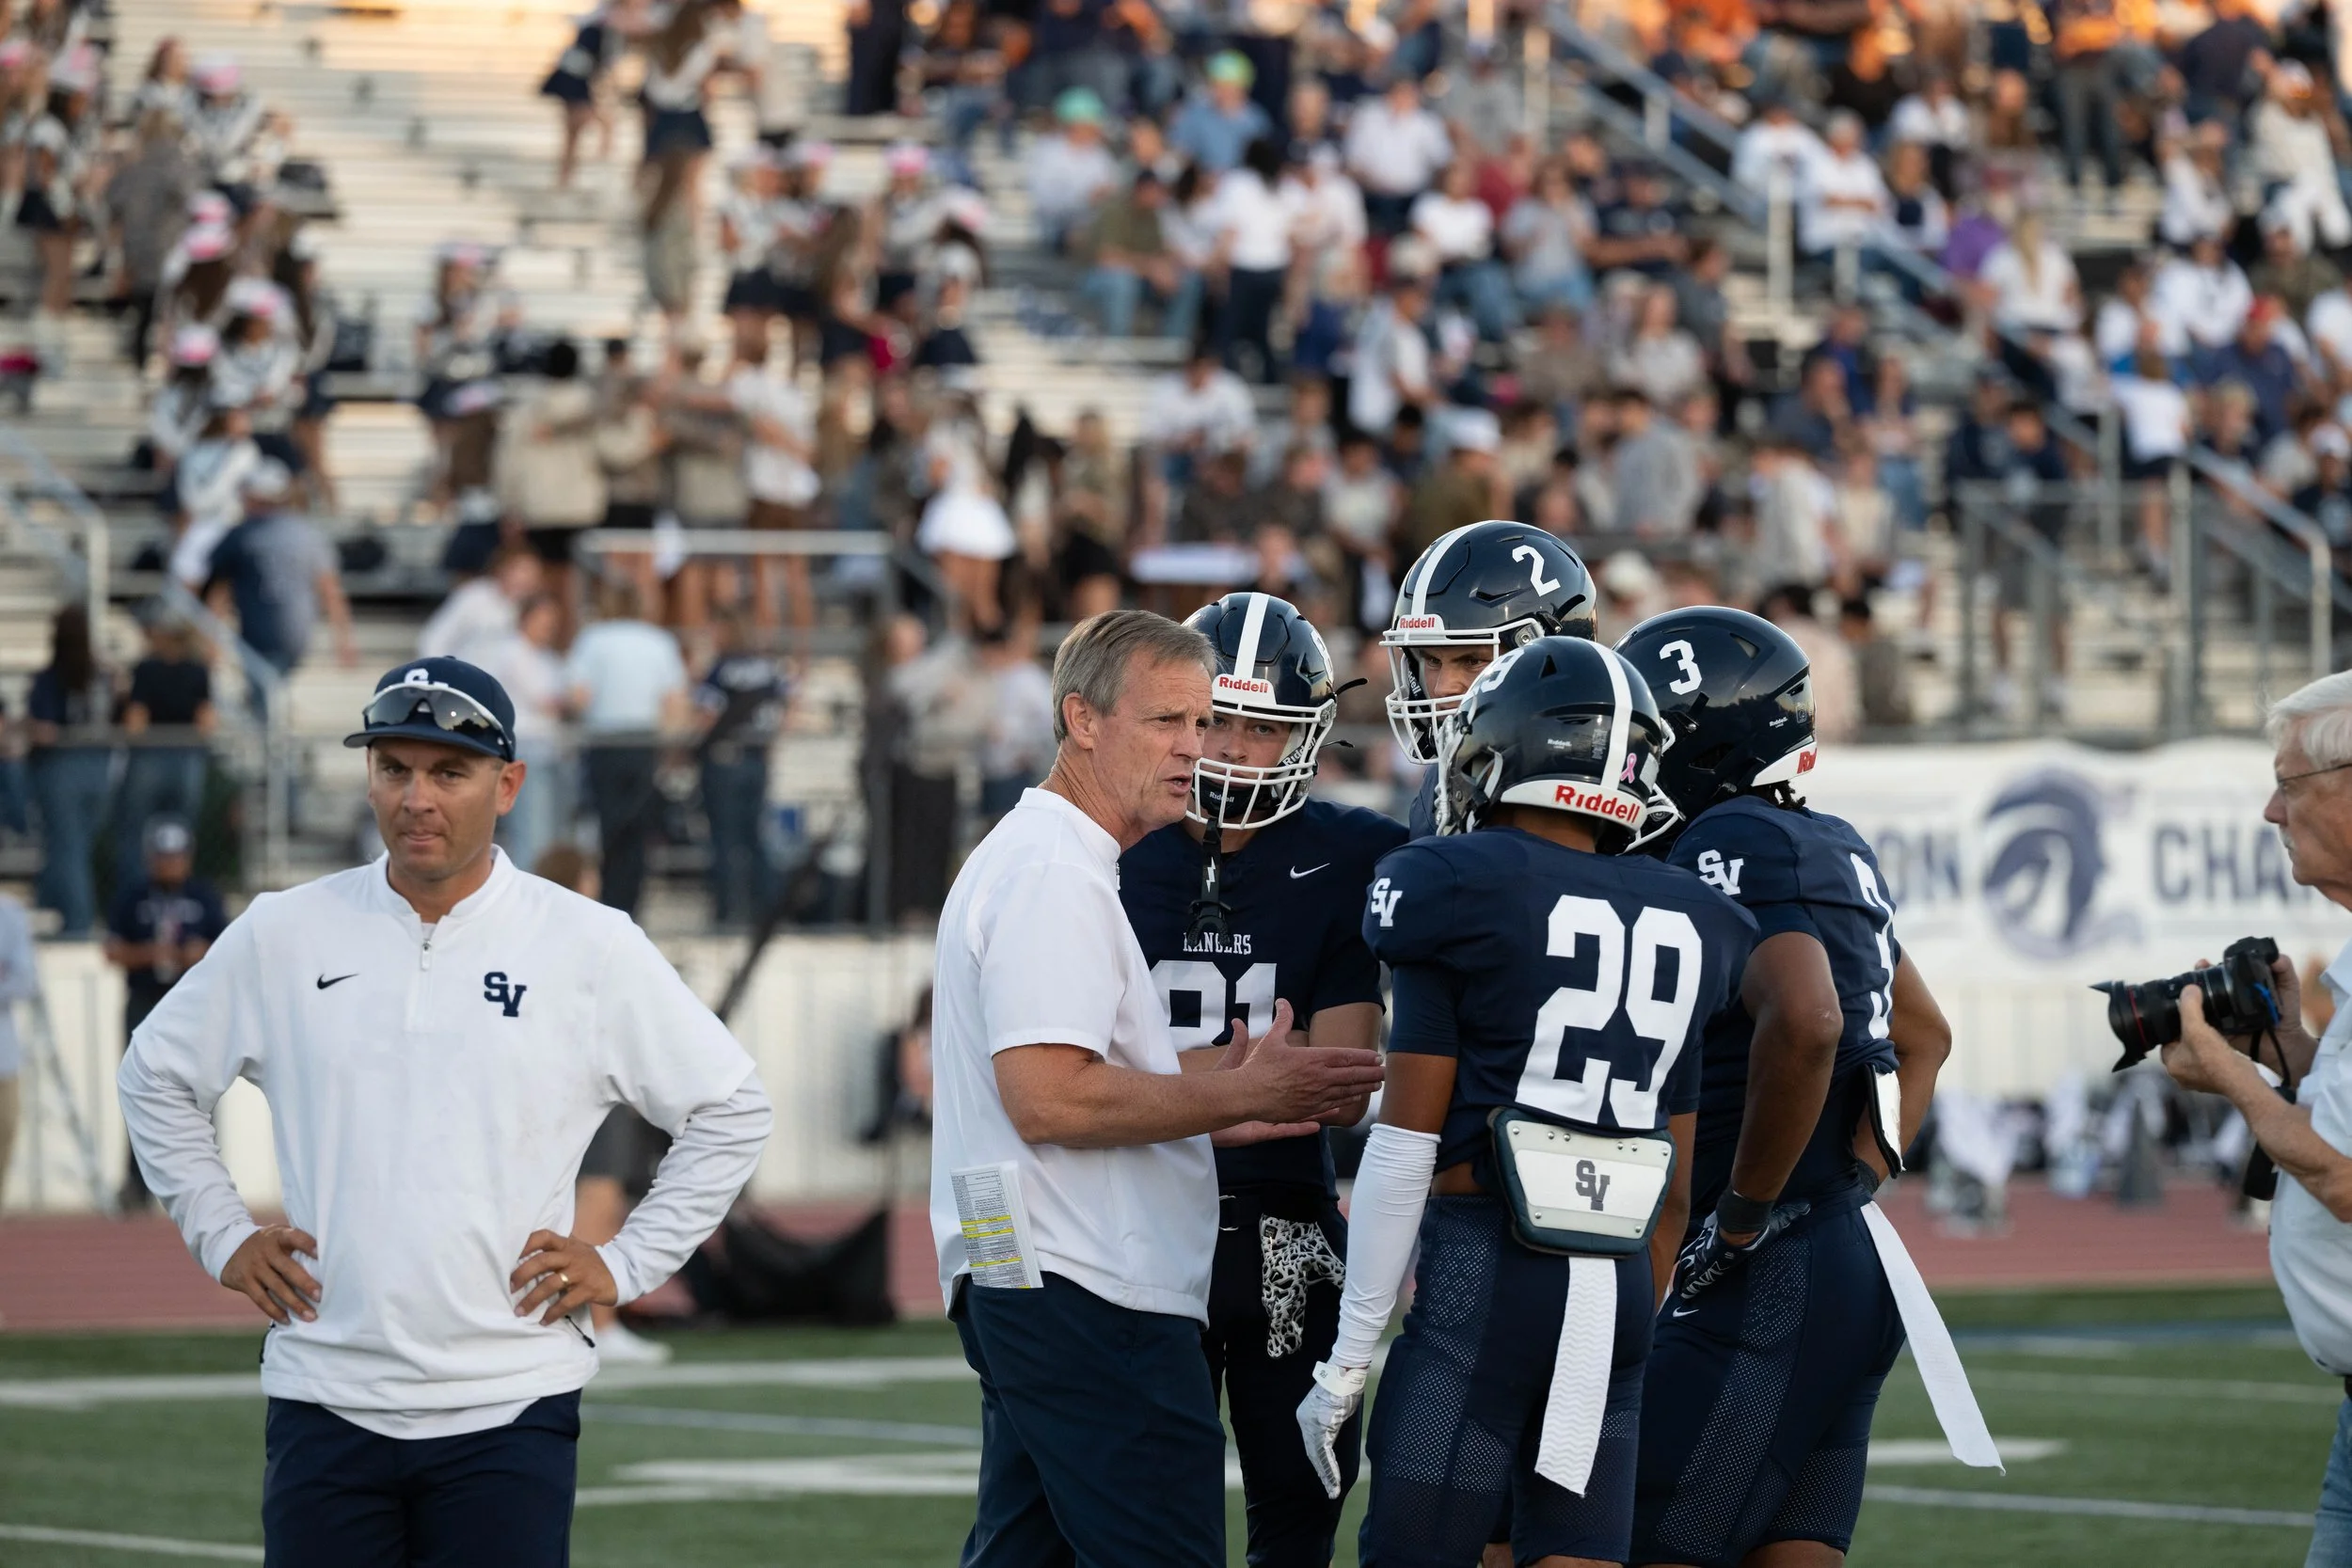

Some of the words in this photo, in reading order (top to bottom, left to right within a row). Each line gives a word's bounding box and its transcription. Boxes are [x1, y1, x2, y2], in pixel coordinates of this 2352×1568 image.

[1512, 545, 1561, 597] 2
[1400, 617, 1436, 629] Riddell
[1218, 676, 1269, 694] Riddell
[1660, 640, 1703, 696] 3
[1555, 784, 1641, 824] Riddell
[1697, 848, 1744, 896] SV
[1371, 877, 1403, 927] SV
[484, 972, 527, 1018] SV
[1516, 895, 1703, 1130] 29
[1575, 1159, 1611, 1212] SV
